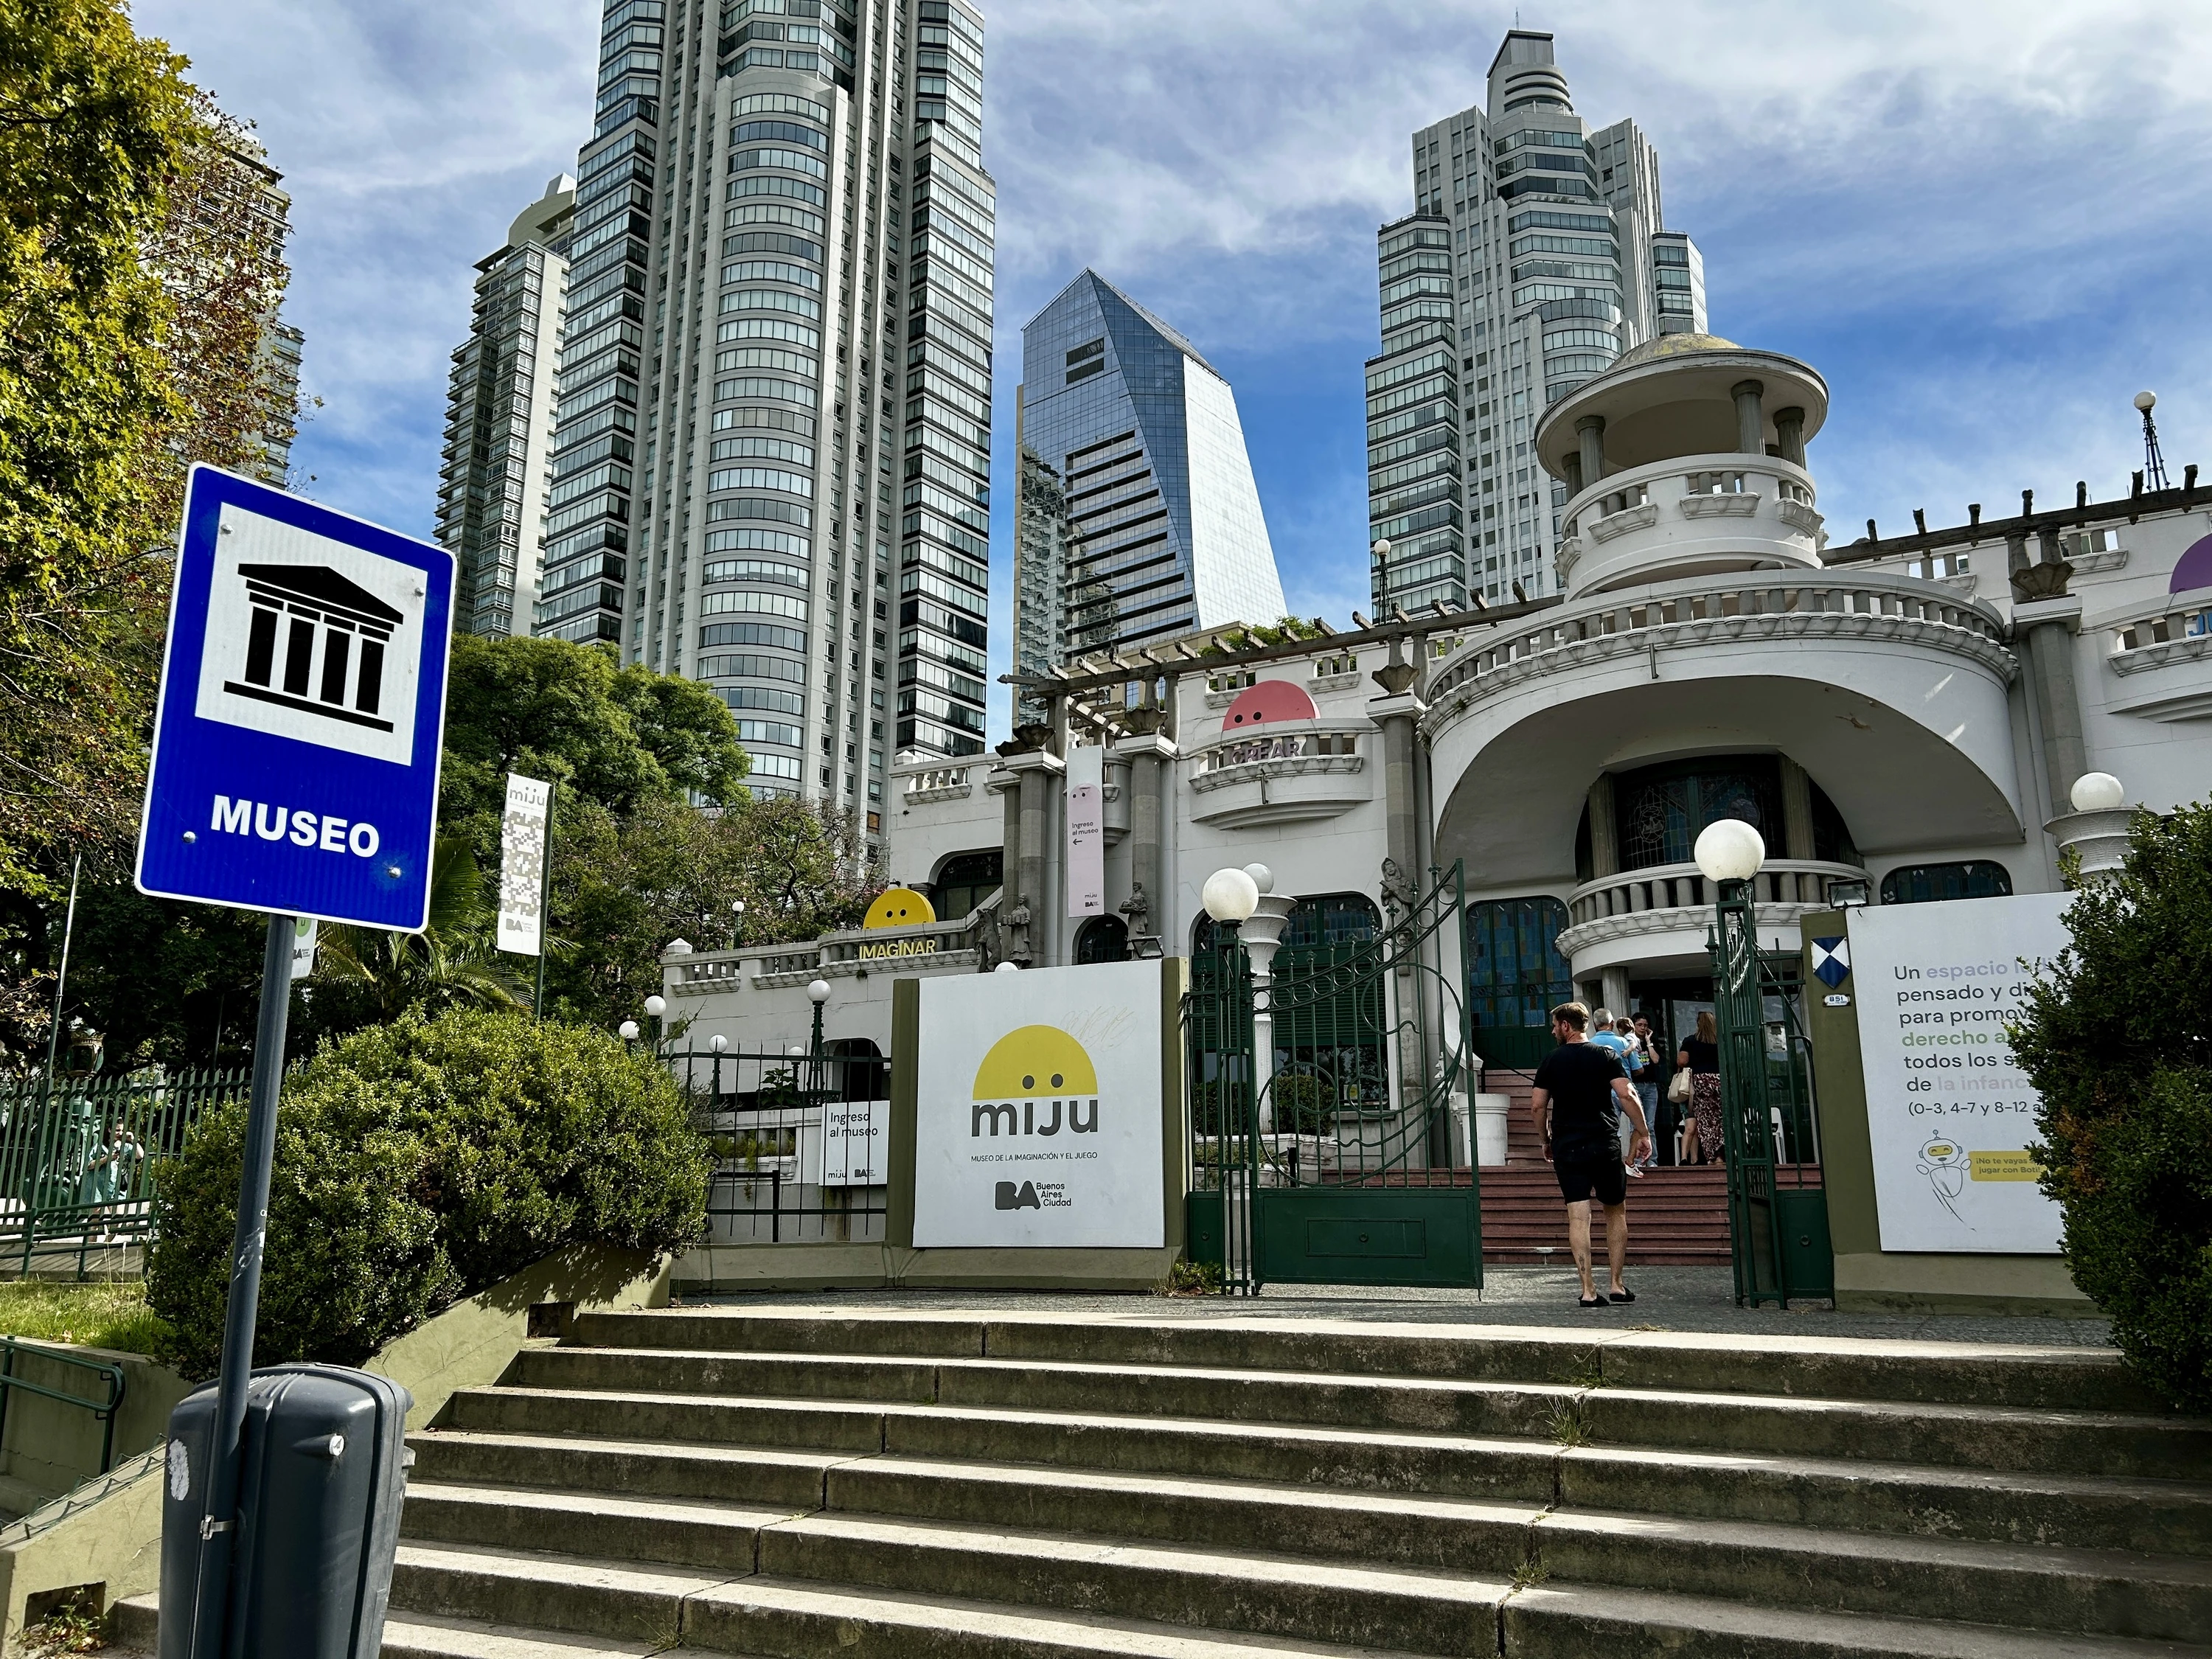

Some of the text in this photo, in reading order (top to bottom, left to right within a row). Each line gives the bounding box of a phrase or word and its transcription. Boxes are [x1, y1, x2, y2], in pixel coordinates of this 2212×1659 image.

[2188, 613, 2212, 636] J
[1231, 742, 1300, 764] CREAR
[509, 786, 545, 806] miju
[211, 794, 379, 858] MUSEO
[859, 940, 936, 959] IMAGINAR
[1894, 966, 1920, 979] Un
[1926, 961, 2008, 981] espacio
[1897, 985, 1984, 1006] pensado
[1989, 987, 2002, 1002] y
[1899, 1012, 1944, 1028] para
[1902, 1030, 1988, 1046] derecho
[1904, 1054, 1962, 1068] todos
[1968, 1053, 1997, 1067] los
[1906, 1077, 1932, 1091] de
[1938, 1077, 1954, 1091] la
[830, 1112, 869, 1125] Ingreso
[972, 1099, 1099, 1137] miju
[1980, 1105, 1989, 1116] y
[830, 1127, 878, 1137] al museo
[1015, 1152, 1059, 1161] IMAGINACIÓN
[995, 1180, 1041, 1210] BA
[1043, 1198, 1071, 1206] Ciudad
